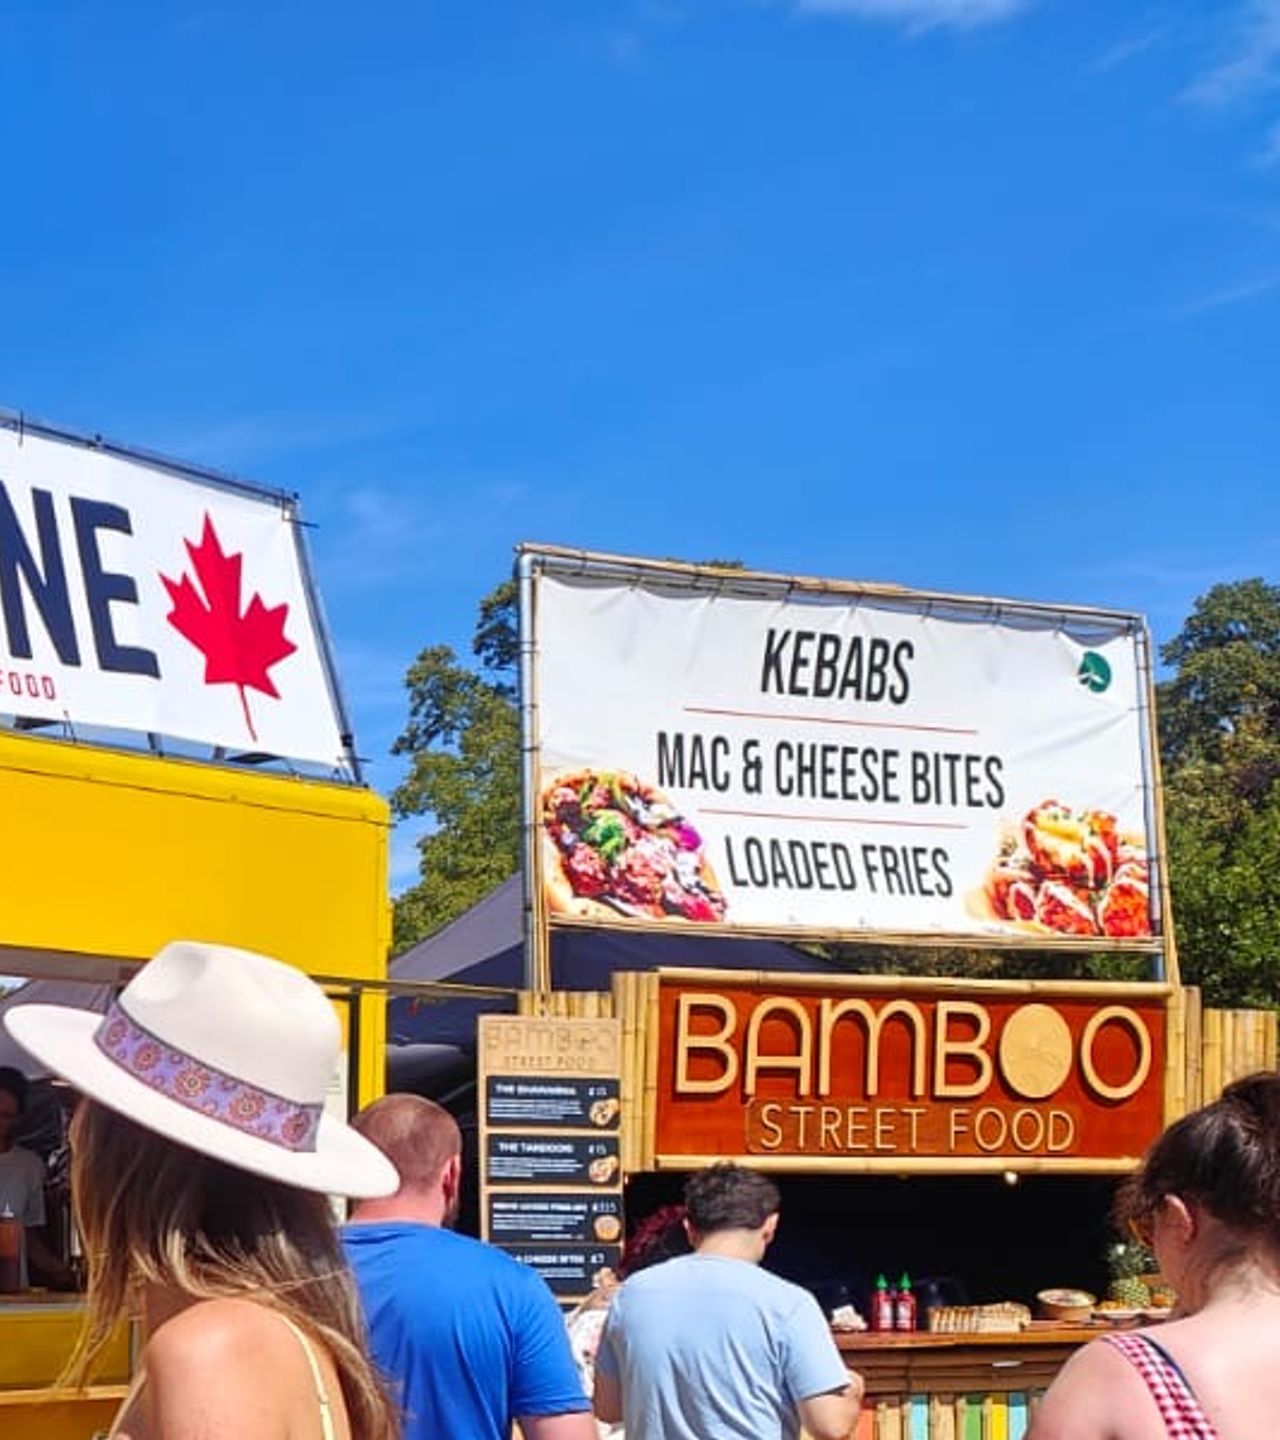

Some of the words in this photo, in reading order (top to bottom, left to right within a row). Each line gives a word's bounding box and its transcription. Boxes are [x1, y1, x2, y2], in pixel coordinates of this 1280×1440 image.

[761, 628, 914, 705] KEBABS
[657, 731, 731, 792] MAC
[742, 739, 764, 795] &
[775, 741, 900, 804] CHEESE
[911, 751, 1005, 809] BITES
[725, 835, 858, 892] LOADED
[861, 844, 953, 898] FRIES
[674, 992, 1152, 1100] BAMBOO
[759, 1103, 927, 1150] STREET
[949, 1106, 1076, 1152] FOOD
